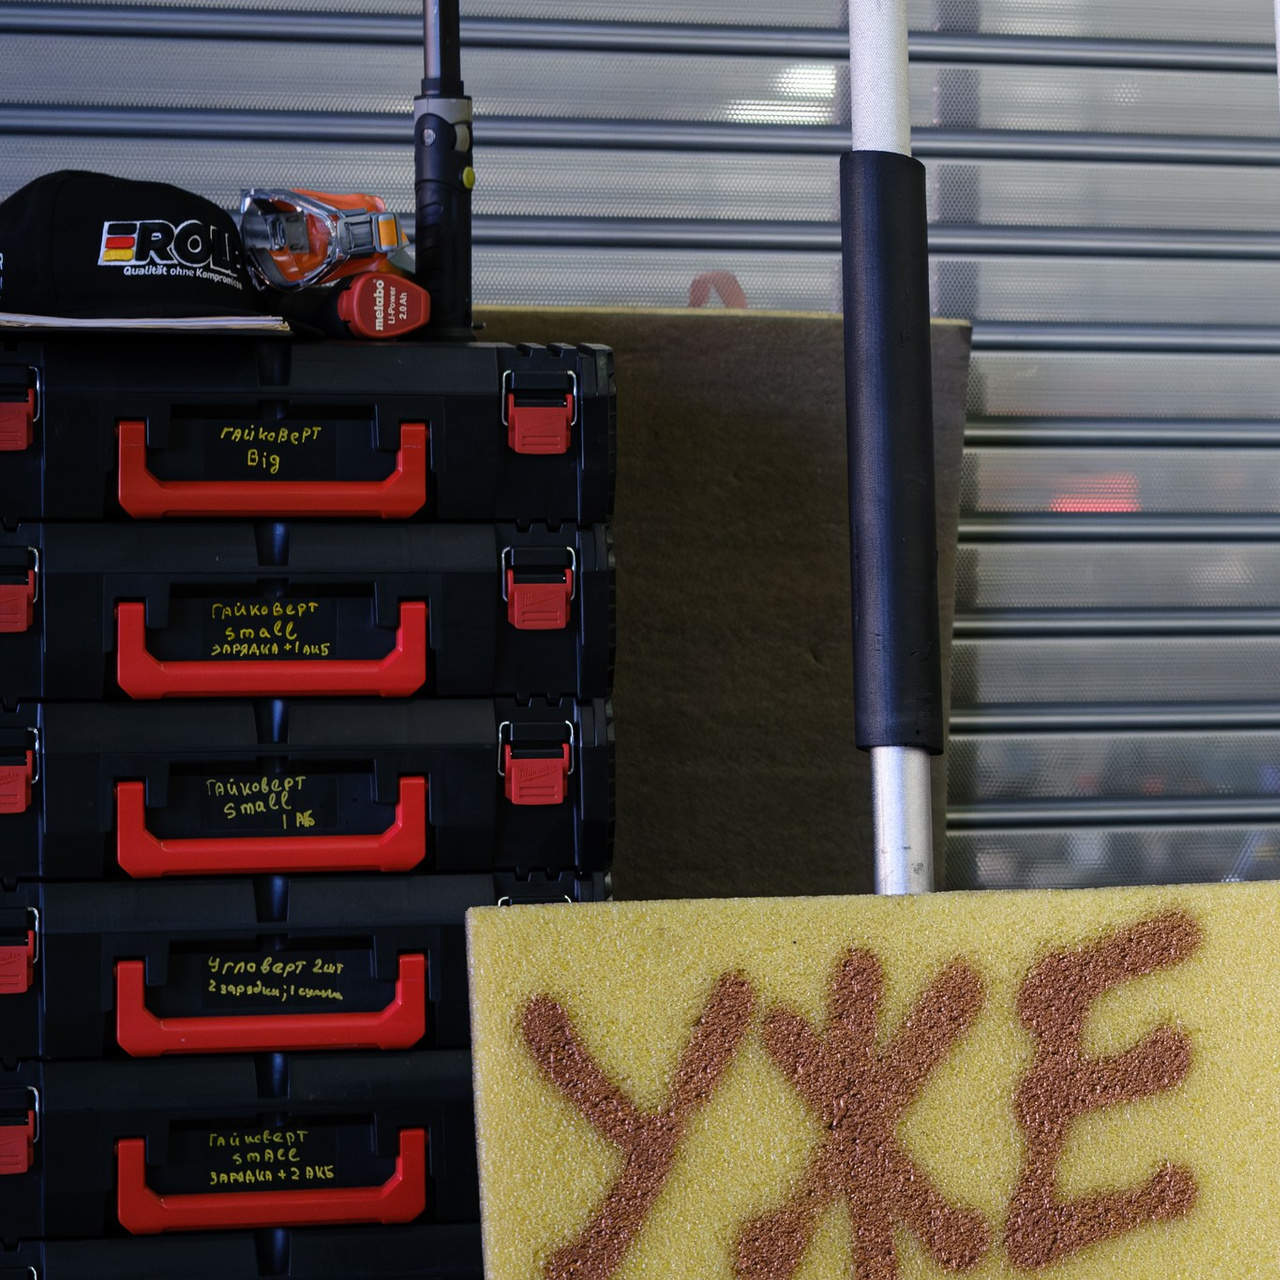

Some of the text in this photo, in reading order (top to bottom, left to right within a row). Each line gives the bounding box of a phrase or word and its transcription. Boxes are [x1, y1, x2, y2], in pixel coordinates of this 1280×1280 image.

[124, 266, 168, 276] Qualität
[169, 266, 194, 277] ohne
[374, 279, 385, 331] metabo
[387, 286, 396, 324] Li-Power
[399, 292, 407, 320] 2.0 Ah
[247, 449, 280, 474] Big
[225, 620, 298, 641] small
[223, 790, 292, 819] small
[208, 979, 216, 992] 2
[305, 1164, 335, 1180] АКБ
